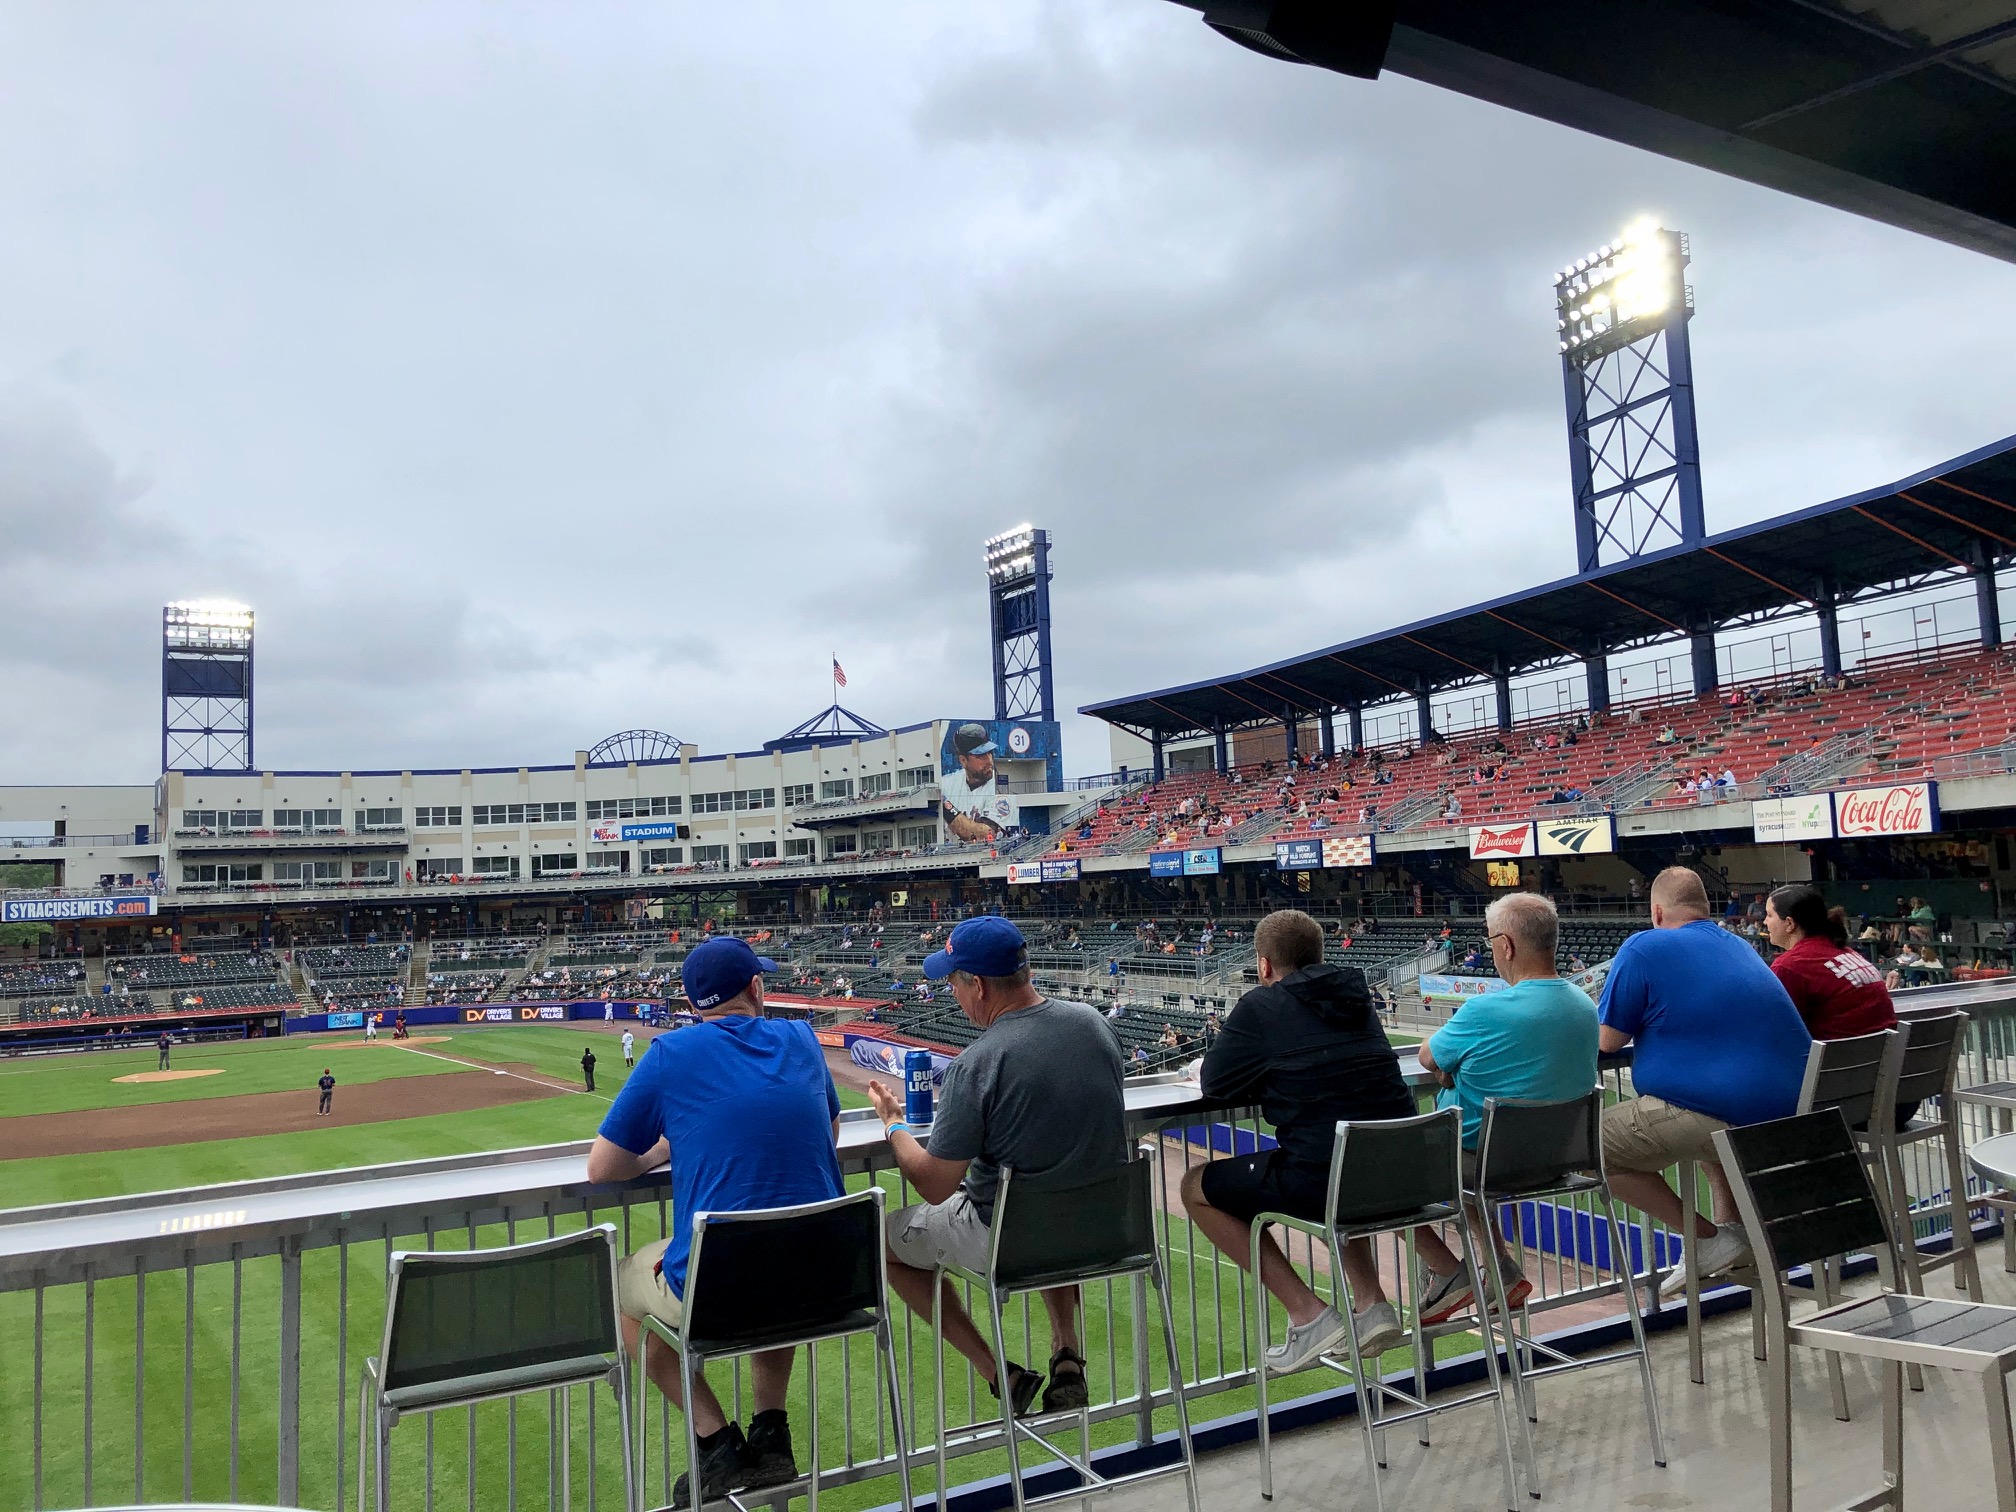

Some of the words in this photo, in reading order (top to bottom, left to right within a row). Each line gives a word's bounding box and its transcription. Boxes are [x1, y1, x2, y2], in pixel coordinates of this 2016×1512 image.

[1014, 734, 1025, 747] 31
[1840, 786, 1925, 834] Coca-Cola
[1556, 817, 1598, 825] AMTRAK
[625, 826, 673, 837] STADIUM
[1478, 833, 1525, 849] Budweiser
[1018, 867, 1040, 878] LUMBER
[10, 900, 146, 918] SYRACUSEMETS.com
[697, 994, 720, 1007] CHIEFS
[377, 1013, 383, 1022] 2
[466, 1009, 486, 1021] DV
[521, 1008, 540, 1019] DV
